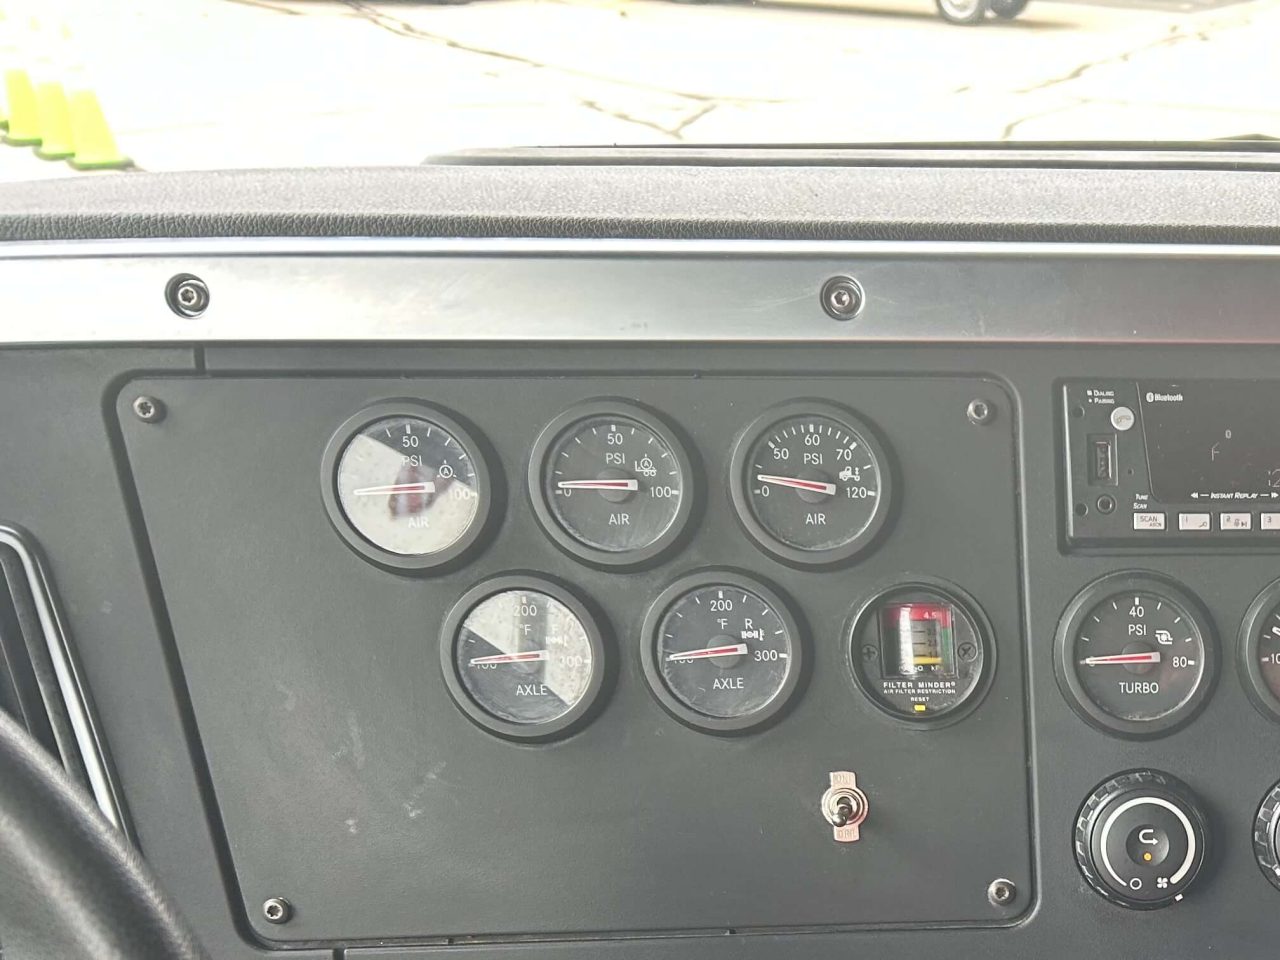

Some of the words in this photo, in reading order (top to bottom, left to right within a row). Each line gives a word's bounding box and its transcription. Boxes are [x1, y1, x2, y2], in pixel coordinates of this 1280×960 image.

[1154, 393, 1183, 401] Bluetooth
[402, 436, 419, 448] 50
[607, 433, 624, 445] 50
[804, 434, 820, 446] 60
[605, 453, 626, 465] PSI
[773, 448, 789, 460] 50
[803, 453, 823, 464] PSI
[836, 449, 852, 461] 70
[401, 455, 423, 467] PSI
[650, 486, 672, 498] 100
[761, 485, 770, 497] 0
[846, 487, 867, 499] 120
[408, 517, 429, 528] AIR
[608, 514, 630, 525] AIR
[805, 513, 826, 525] AIR
[514, 604, 537, 617] 200
[710, 600, 733, 612] 200
[1128, 606, 1145, 618] 40
[744, 618, 753, 630] R
[1128, 624, 1147, 636] PSI
[754, 649, 778, 662] 300
[1172, 656, 1188, 668] 80
[516, 684, 548, 696] AXLE
[713, 678, 745, 690] AXLE
[1119, 682, 1159, 694] TURBO
